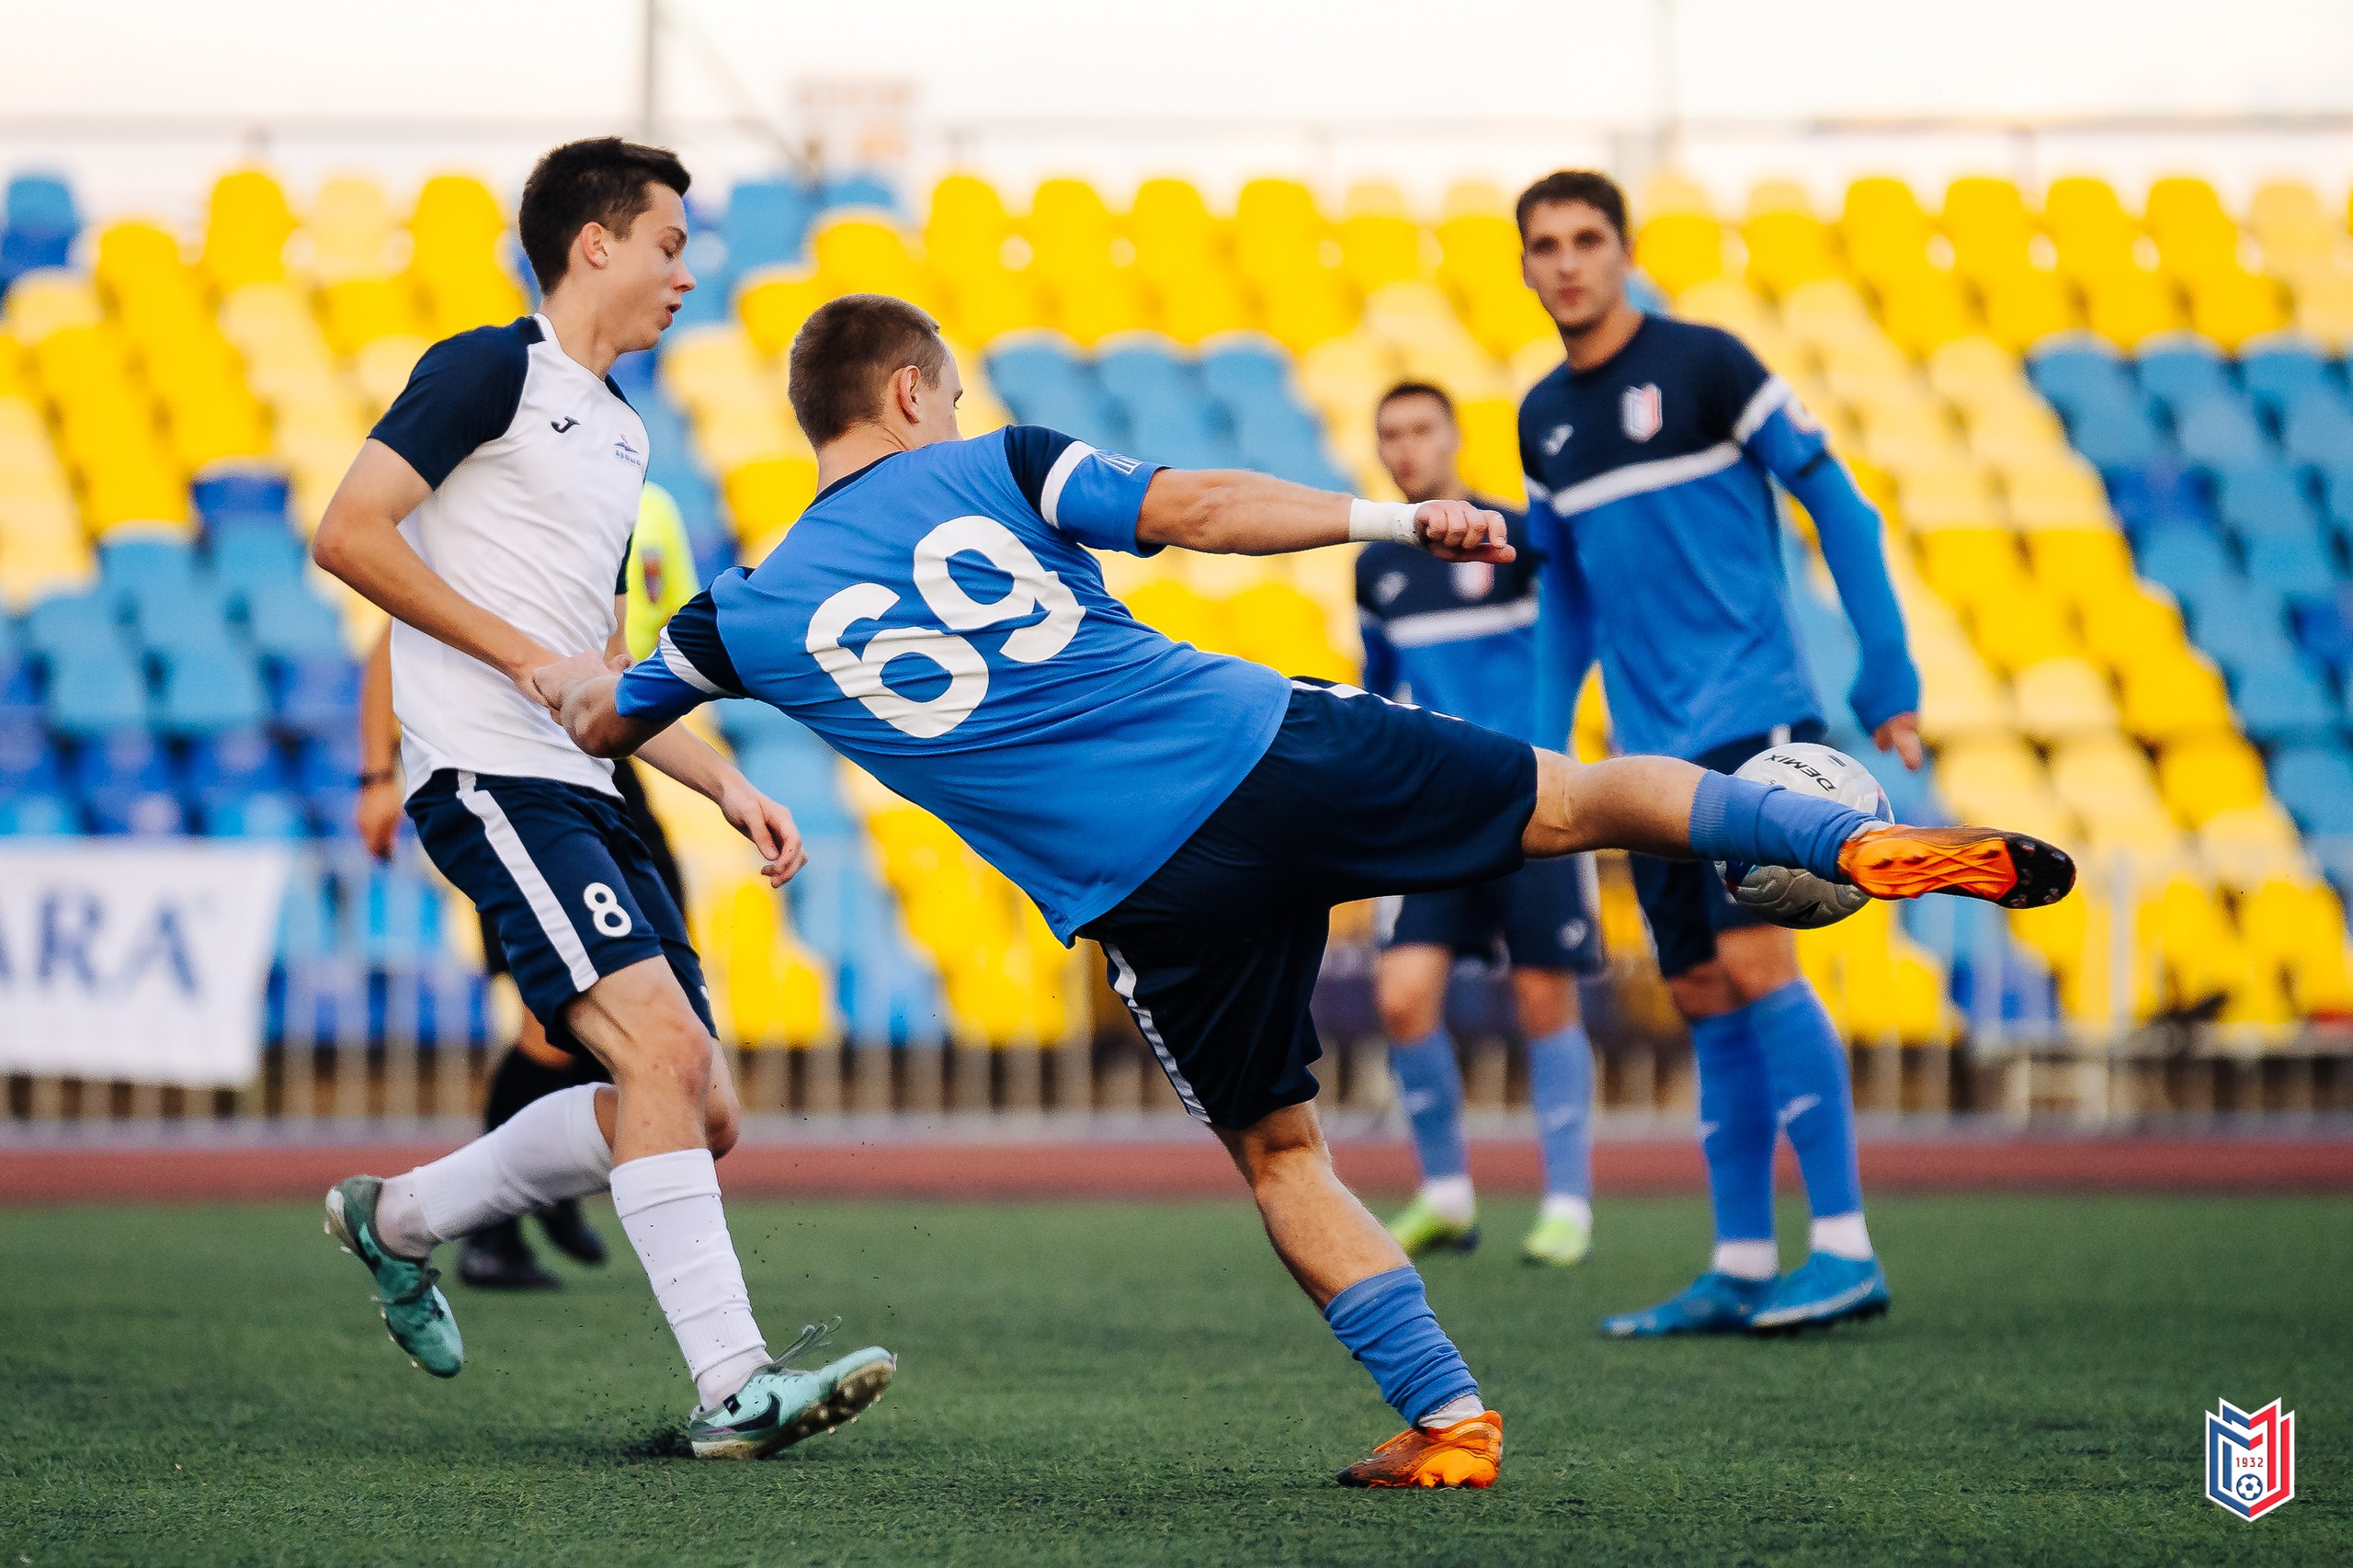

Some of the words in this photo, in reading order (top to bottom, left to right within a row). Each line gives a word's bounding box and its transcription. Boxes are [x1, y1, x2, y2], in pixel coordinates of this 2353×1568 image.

[805, 515, 1086, 739] 69
[1764, 754, 1837, 792] DEMIX
[583, 882, 632, 937] 8
